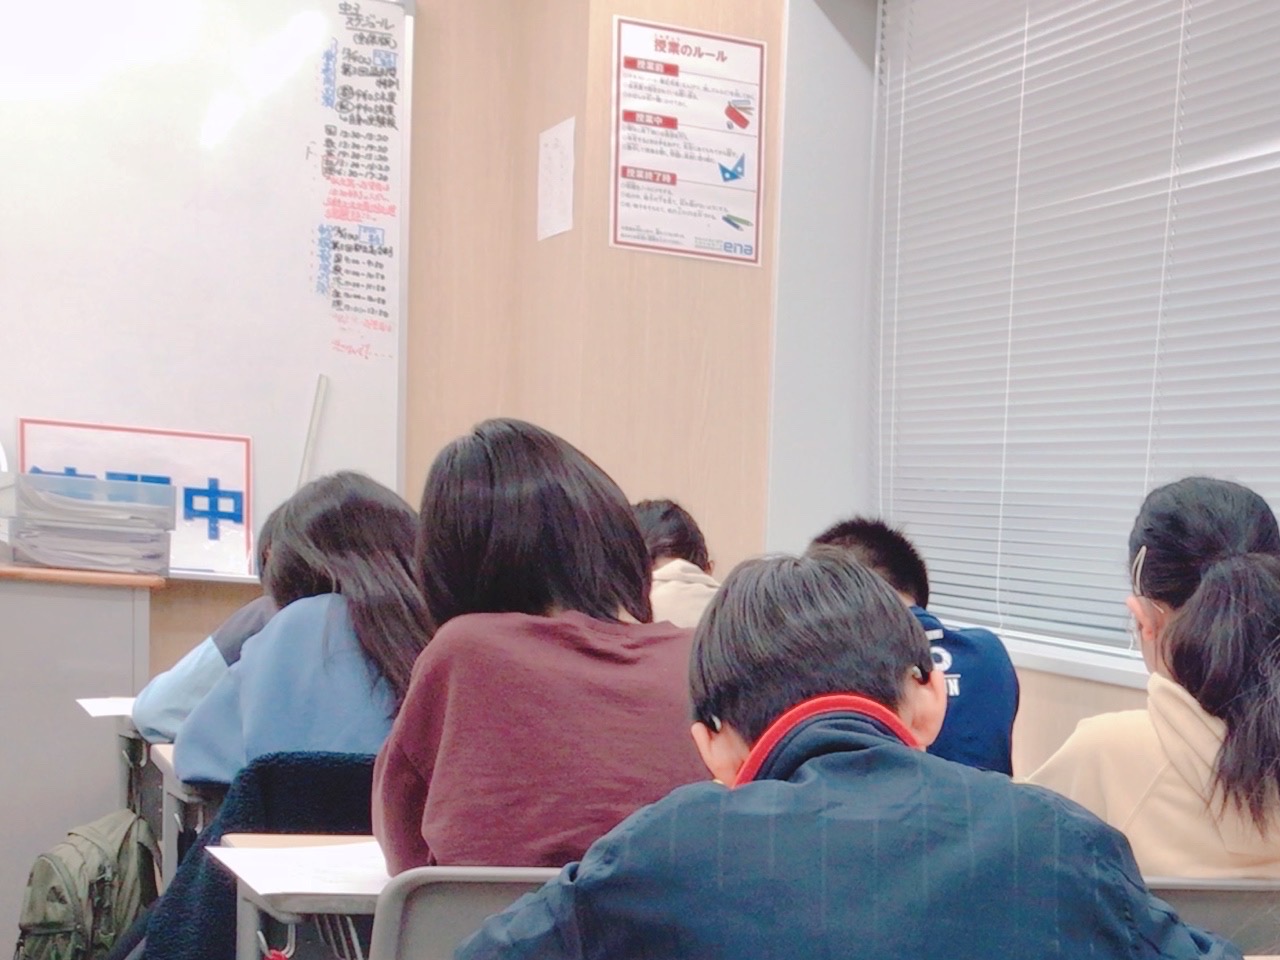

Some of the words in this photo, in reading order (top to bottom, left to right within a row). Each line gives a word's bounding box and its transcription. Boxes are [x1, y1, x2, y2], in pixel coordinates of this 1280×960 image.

[654, 38, 728, 62] 授業のルール
[635, 113, 664, 126] 授業中
[723, 241, 754, 256] ena
